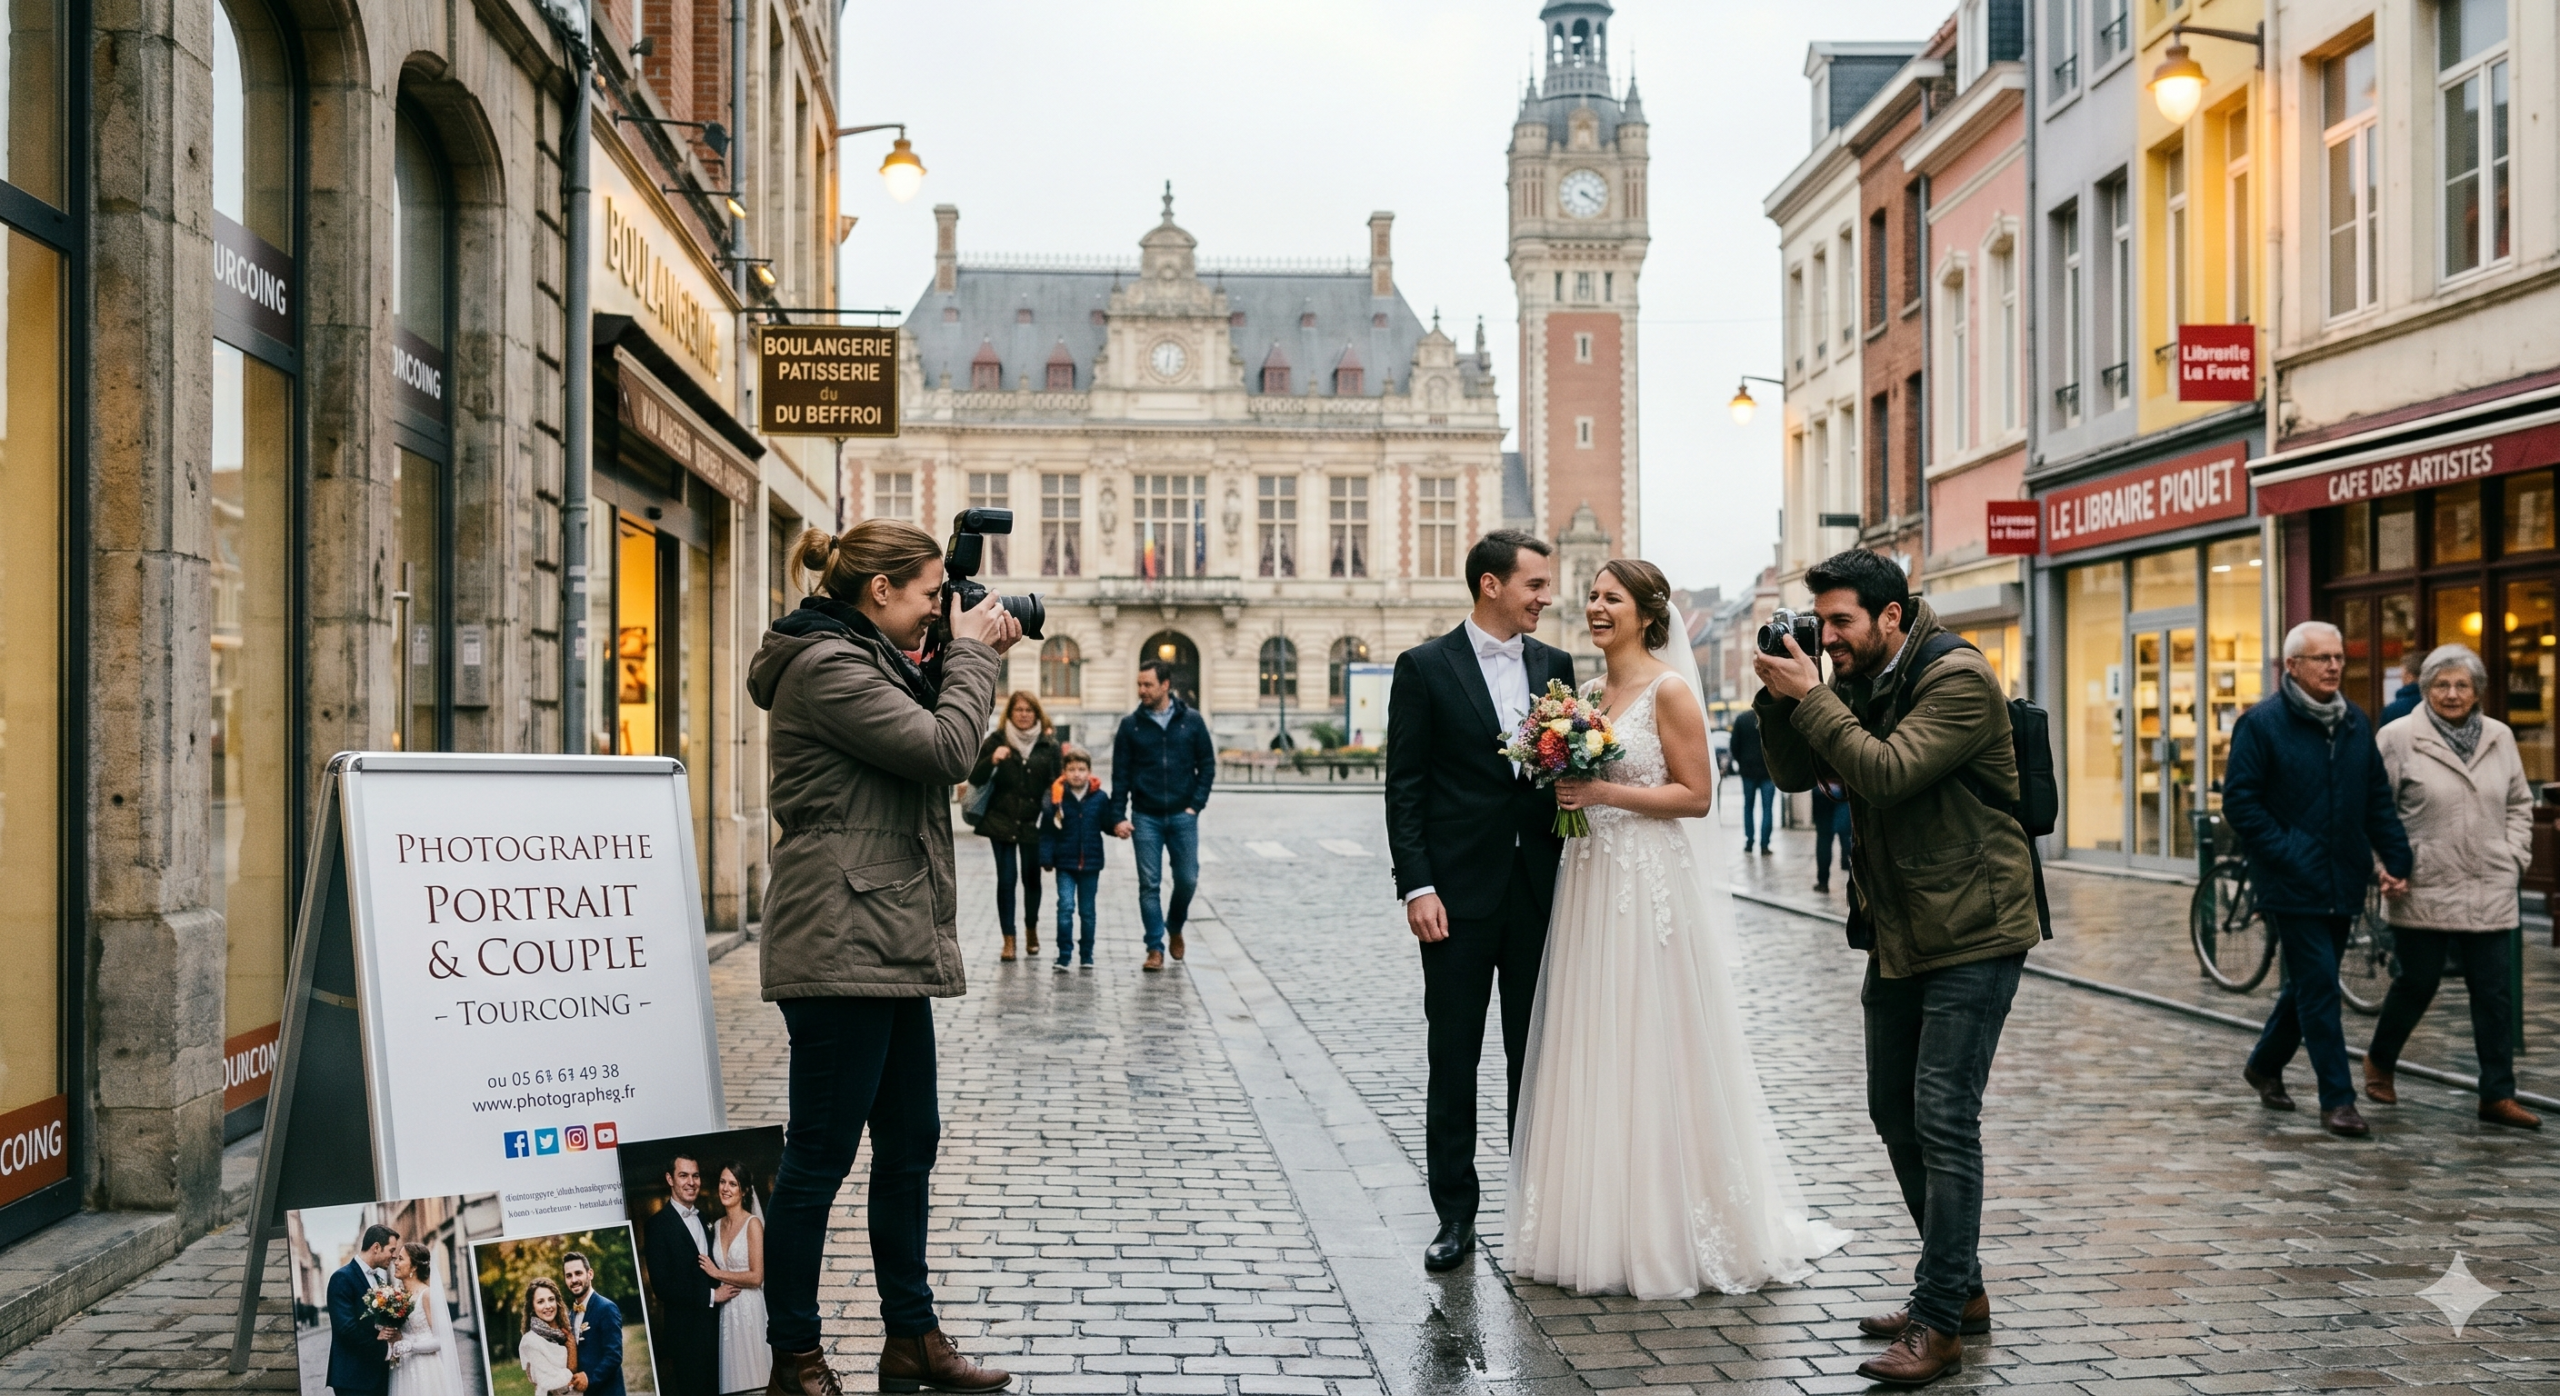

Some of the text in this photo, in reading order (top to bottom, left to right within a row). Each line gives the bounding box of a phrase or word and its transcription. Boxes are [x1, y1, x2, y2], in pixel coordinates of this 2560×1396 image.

[764, 336, 892, 357] BOULANGERIE
[778, 362, 880, 381] PATISSERIE
[820, 386, 838, 401] du
[776, 405, 881, 425] DU BEFFROI
[2328, 443, 2493, 502] CAFE DES ARTISTES
[2050, 457, 2236, 540] LE LIBRAIRE PIQUET
[395, 833, 653, 864] PHOTOGRAPHE
[424, 884, 638, 924] PORTRAIT
[428, 936, 647, 980] & COUPLE
[456, 994, 631, 1026] TOURCOING
[487, 1076, 507, 1089] ou
[511, 1071, 531, 1086] 05
[579, 1065, 597, 1080] 49
[601, 1063, 620, 1079] 38
[0, 1119, 62, 1176] COING
